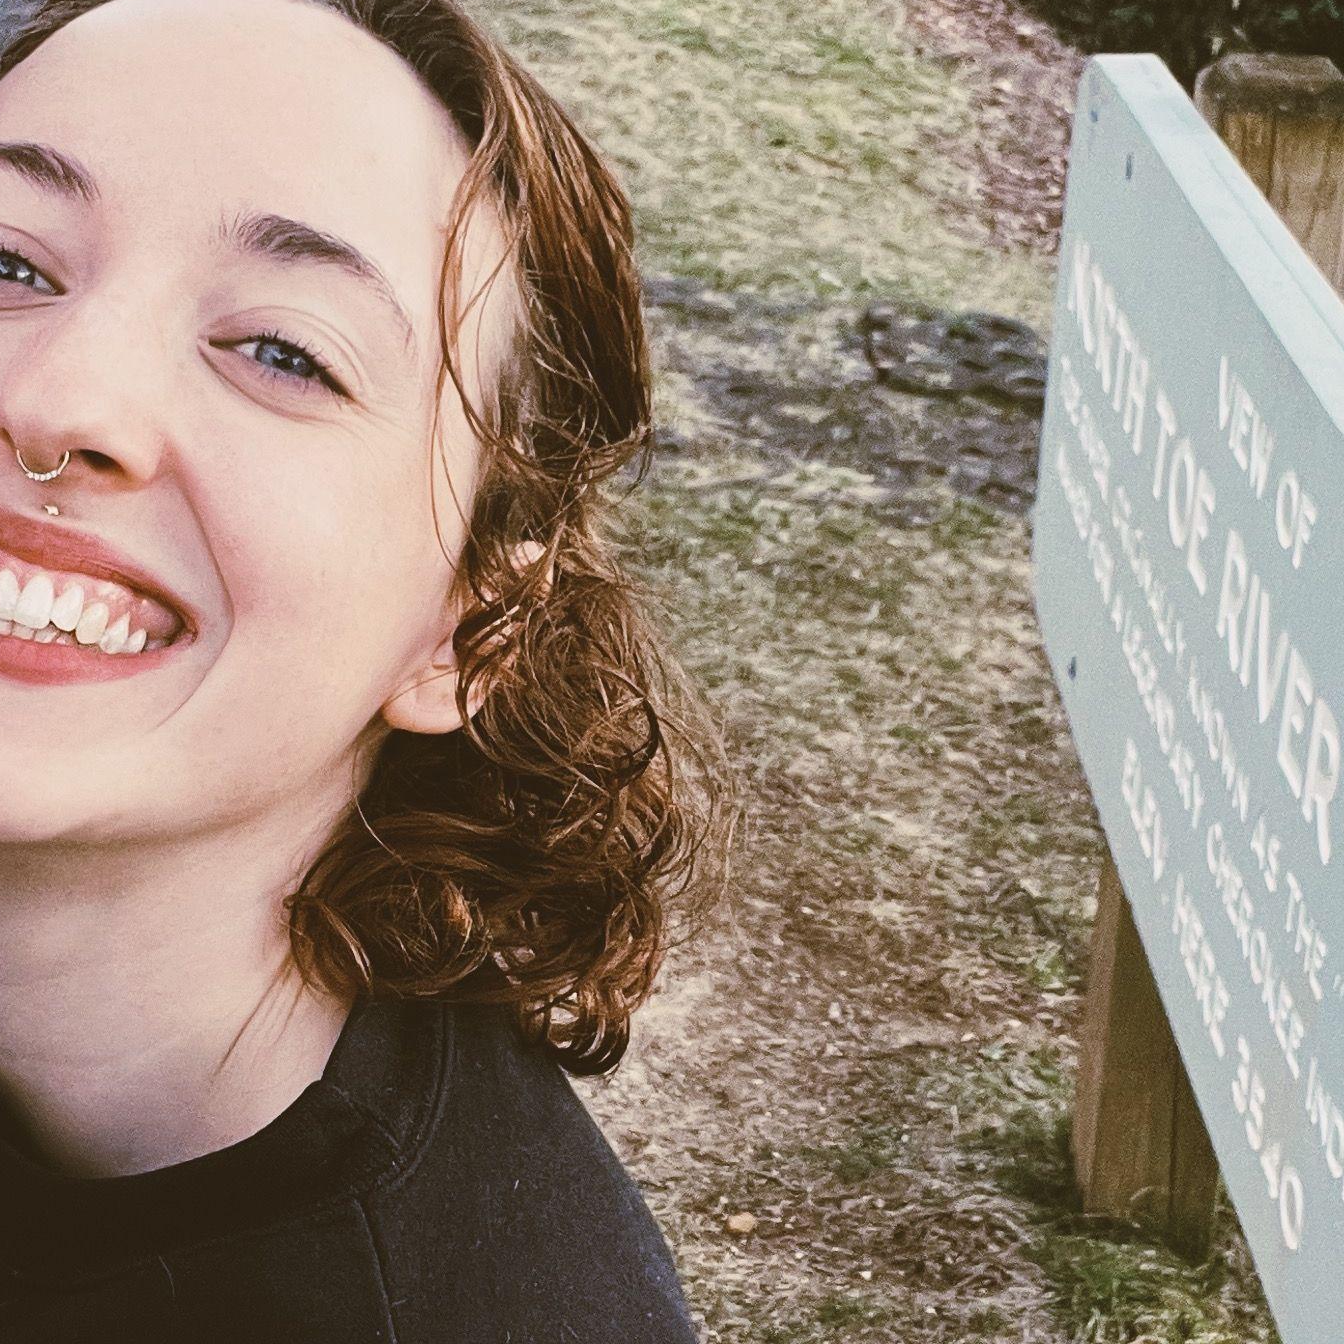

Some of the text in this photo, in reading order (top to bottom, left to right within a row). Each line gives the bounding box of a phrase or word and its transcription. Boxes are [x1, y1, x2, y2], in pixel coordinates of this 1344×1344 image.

[1066, 238, 1151, 455] NORTH
[1152, 388, 1216, 596] TOE
[1216, 528, 1342, 866] RIVER
[1218, 355, 1319, 570] VIEW OF
[1206, 822, 1306, 1081] CHEROKEE
[1250, 817, 1282, 893] AS
[1284, 871, 1328, 1002] THE
[1171, 874, 1231, 1059] HERE
[1230, 1035, 1305, 1252] 3540
